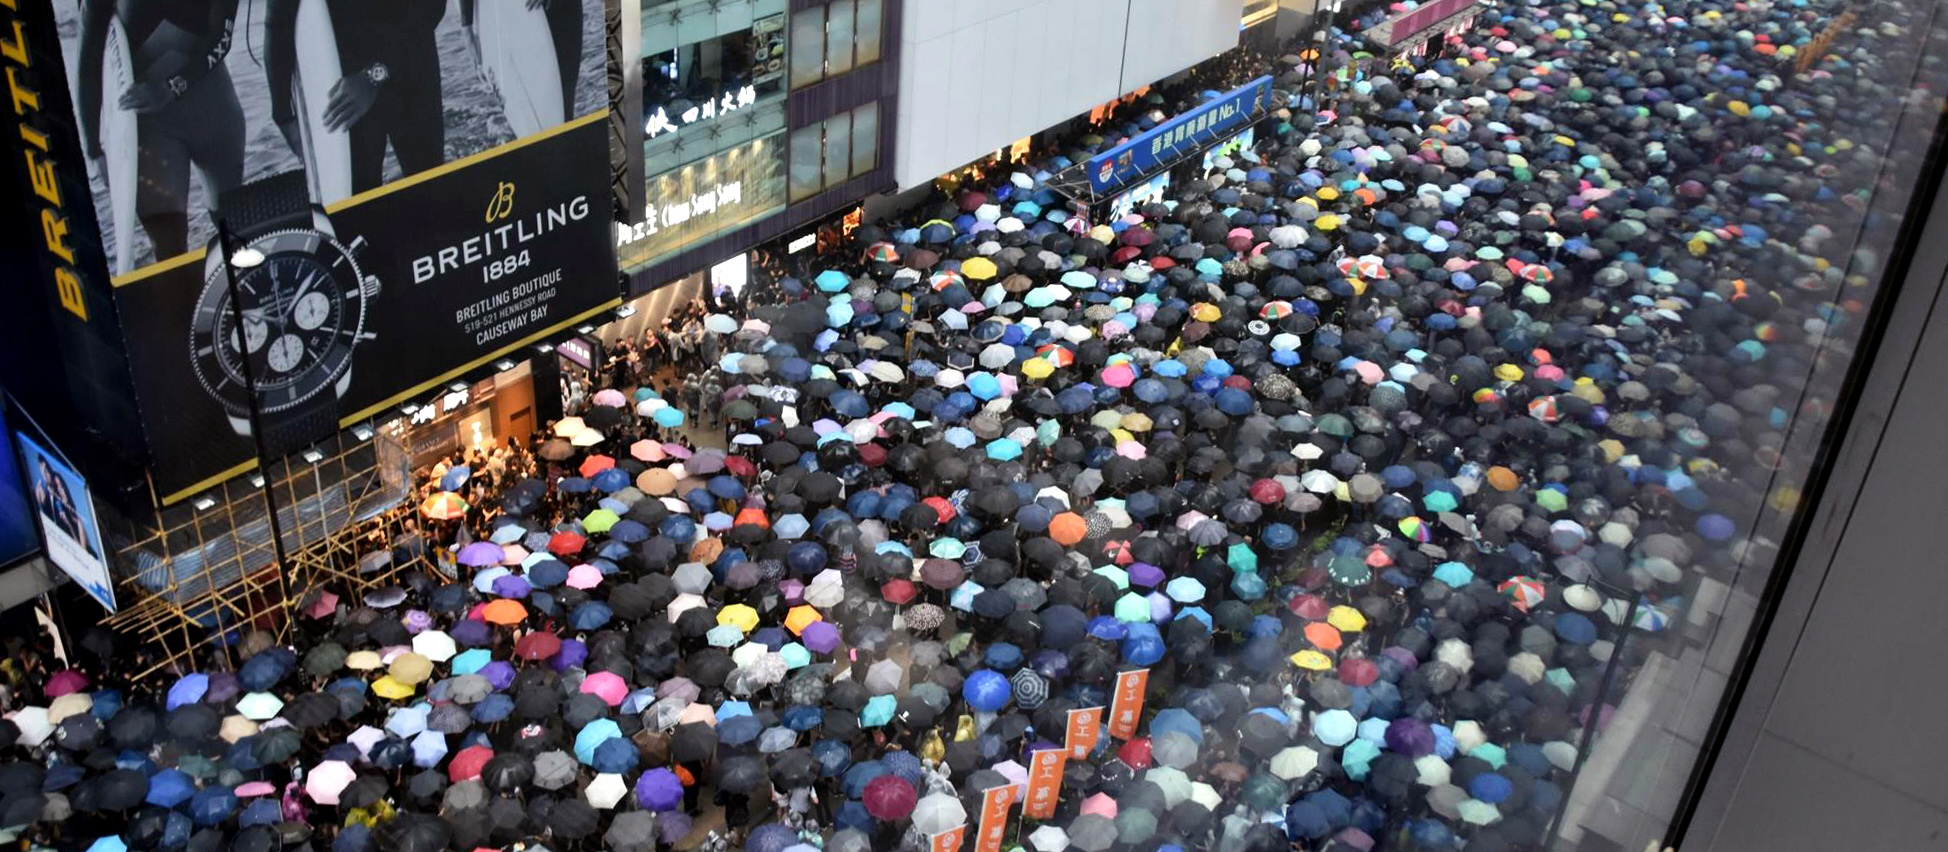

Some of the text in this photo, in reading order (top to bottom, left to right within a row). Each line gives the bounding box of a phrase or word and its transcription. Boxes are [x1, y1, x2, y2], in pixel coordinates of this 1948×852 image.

[412, 195, 589, 284] BREITLING
[483, 249, 531, 283] 1884
[456, 268, 562, 323] BREITLING BOUTIQUE
[464, 287, 556, 334] 519-521 HENNESSY ROAD
[476, 304, 548, 346] CAUSEWAY BAY
